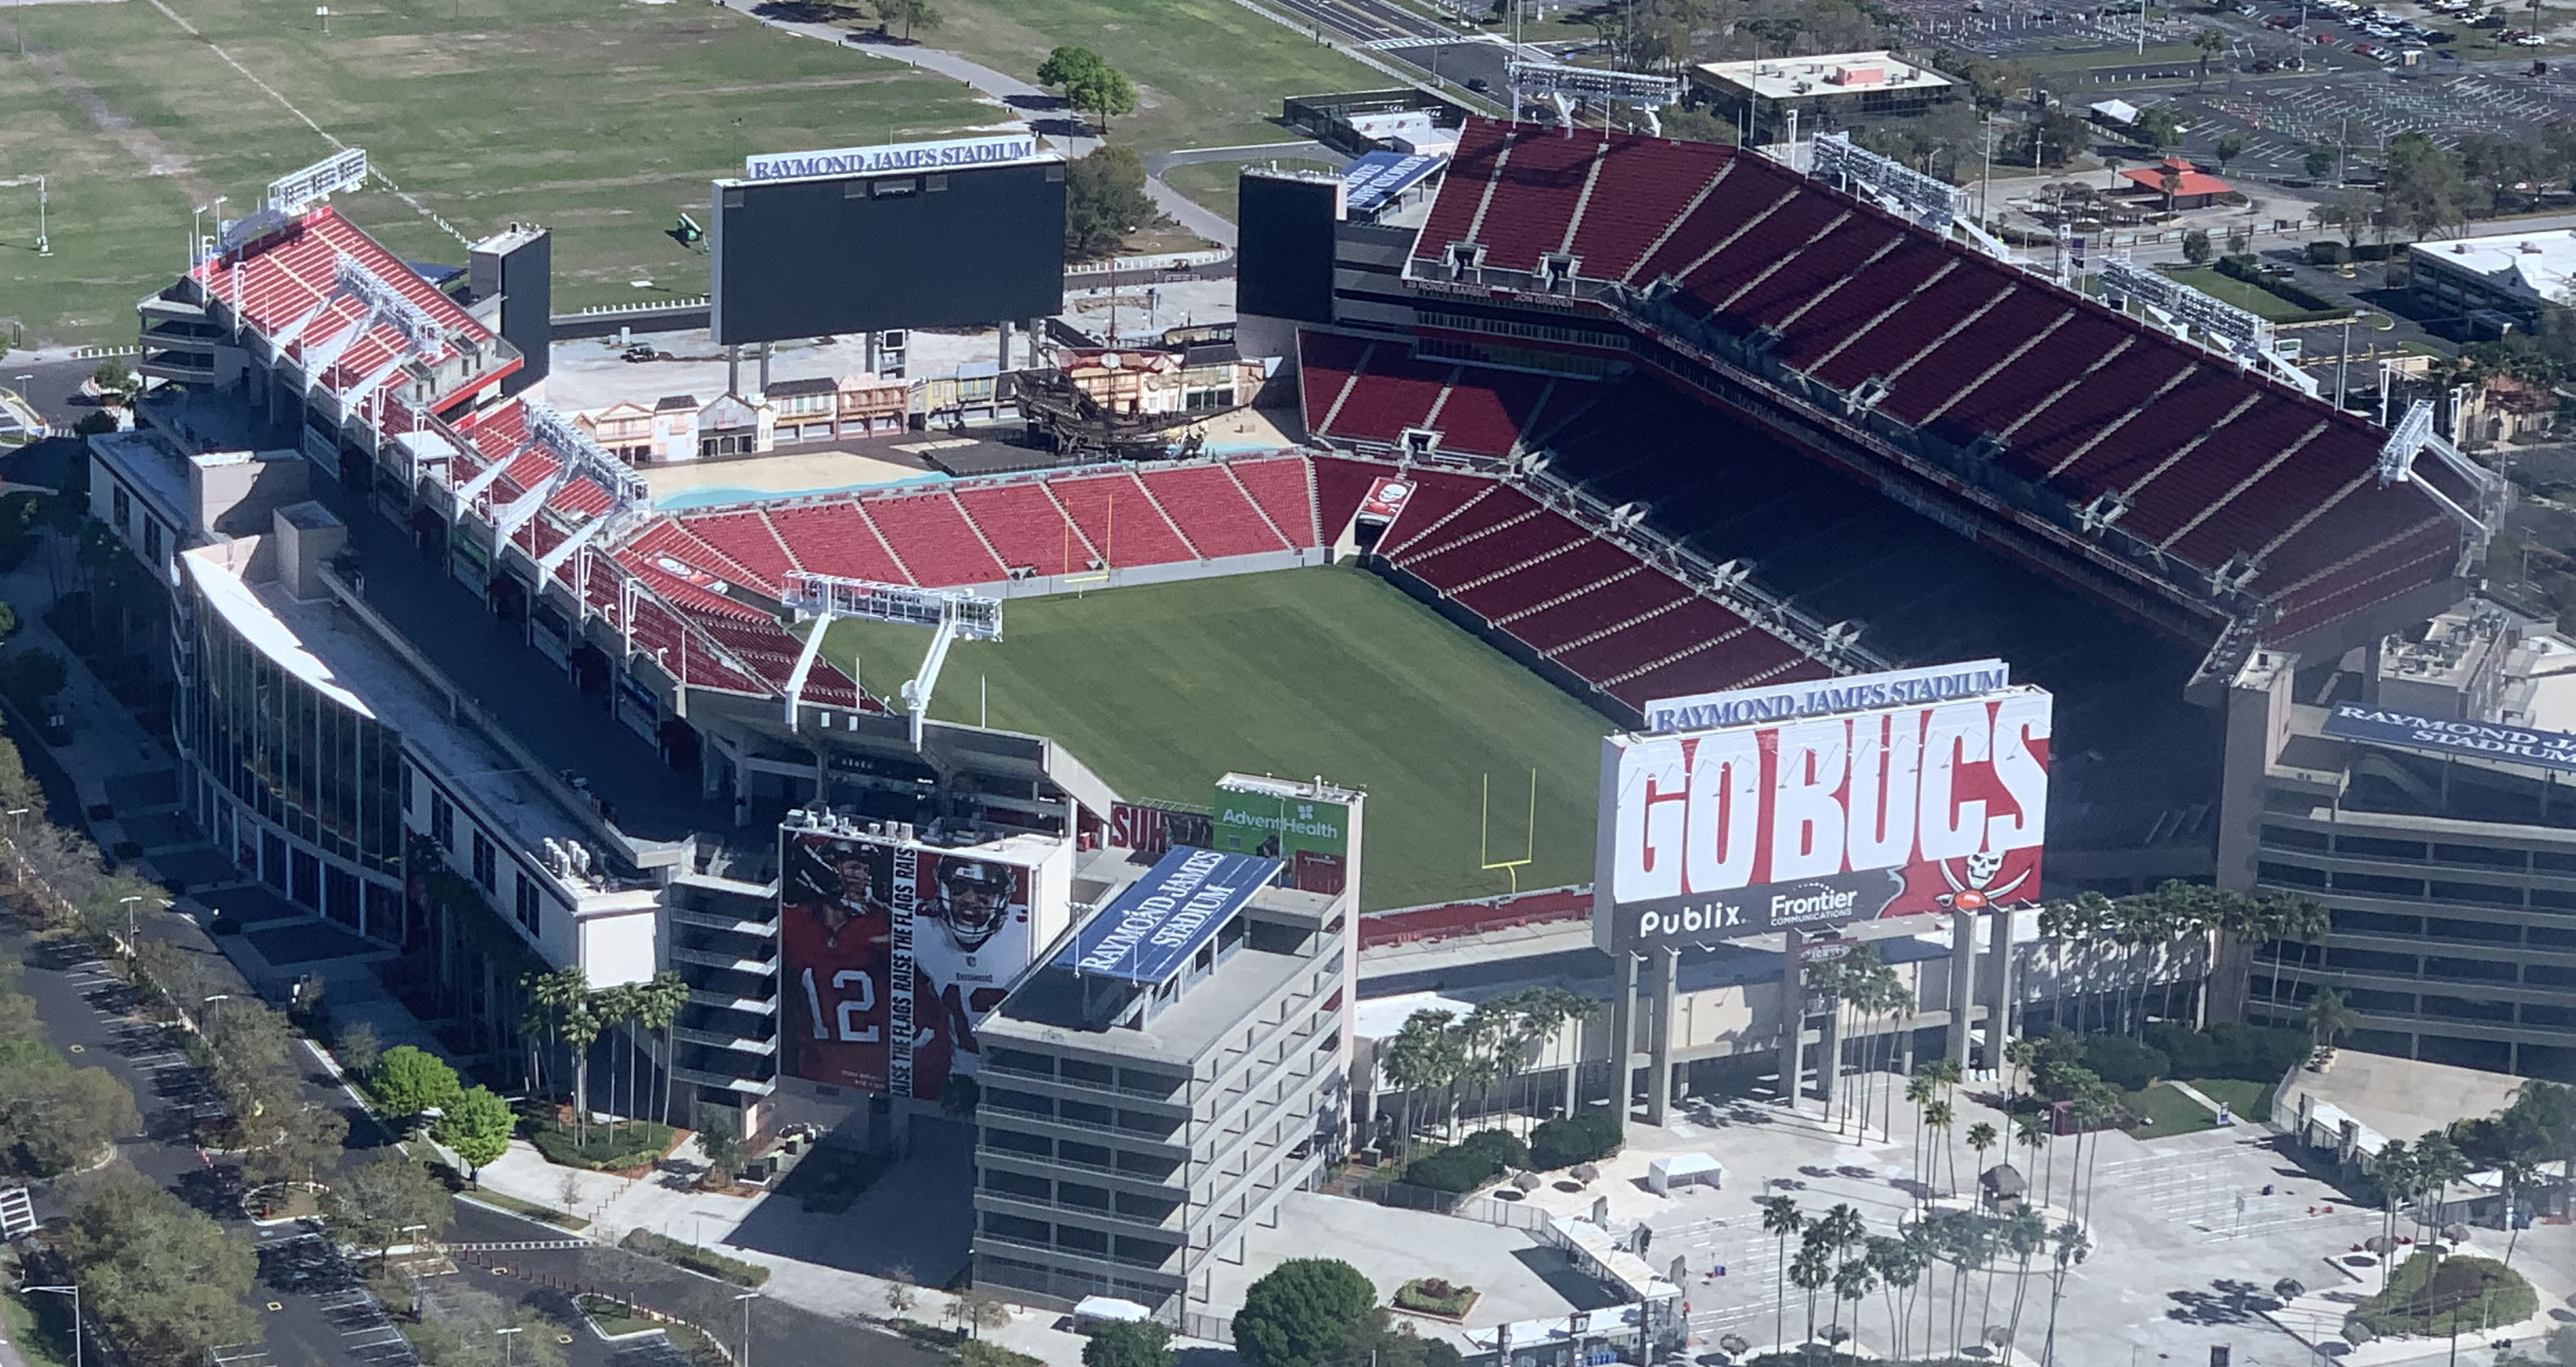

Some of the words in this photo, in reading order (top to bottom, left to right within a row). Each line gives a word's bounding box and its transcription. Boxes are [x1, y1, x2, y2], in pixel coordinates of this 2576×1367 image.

[754, 154, 863, 179] RAYMOND
[867, 148, 936, 171] JAMES
[941, 141, 1032, 165] STADIUM
[1655, 695, 1795, 731] RAYMOND
[1797, 684, 1885, 713] JAMES
[1891, 669, 2005, 703] STADIUM
[2338, 706, 2539, 743] RAYMOND
[2412, 730, 2576, 763] STADIUM
[1613, 729, 1760, 903] GO
[1771, 693, 2052, 884] BUCS
[1112, 805, 1166, 854] SUH
[1223, 808, 1338, 839] AdventHealth
[894, 885, 915, 924] FLAGS
[1078, 896, 1177, 970] RAYMOND
[1158, 850, 1226, 898] JAMES
[1151, 884, 1236, 948] STADIUM
[1640, 902, 1741, 938] Publix
[1770, 908, 1852, 926] COMMUNICATIONS
[1771, 889, 1858, 918] Frontier
[893, 925, 913, 950] THE
[892, 955, 913, 994] RAISE
[801, 967, 879, 1042] 12
[891, 996, 912, 1032] FLAGS
[891, 1033, 912, 1061] THE
